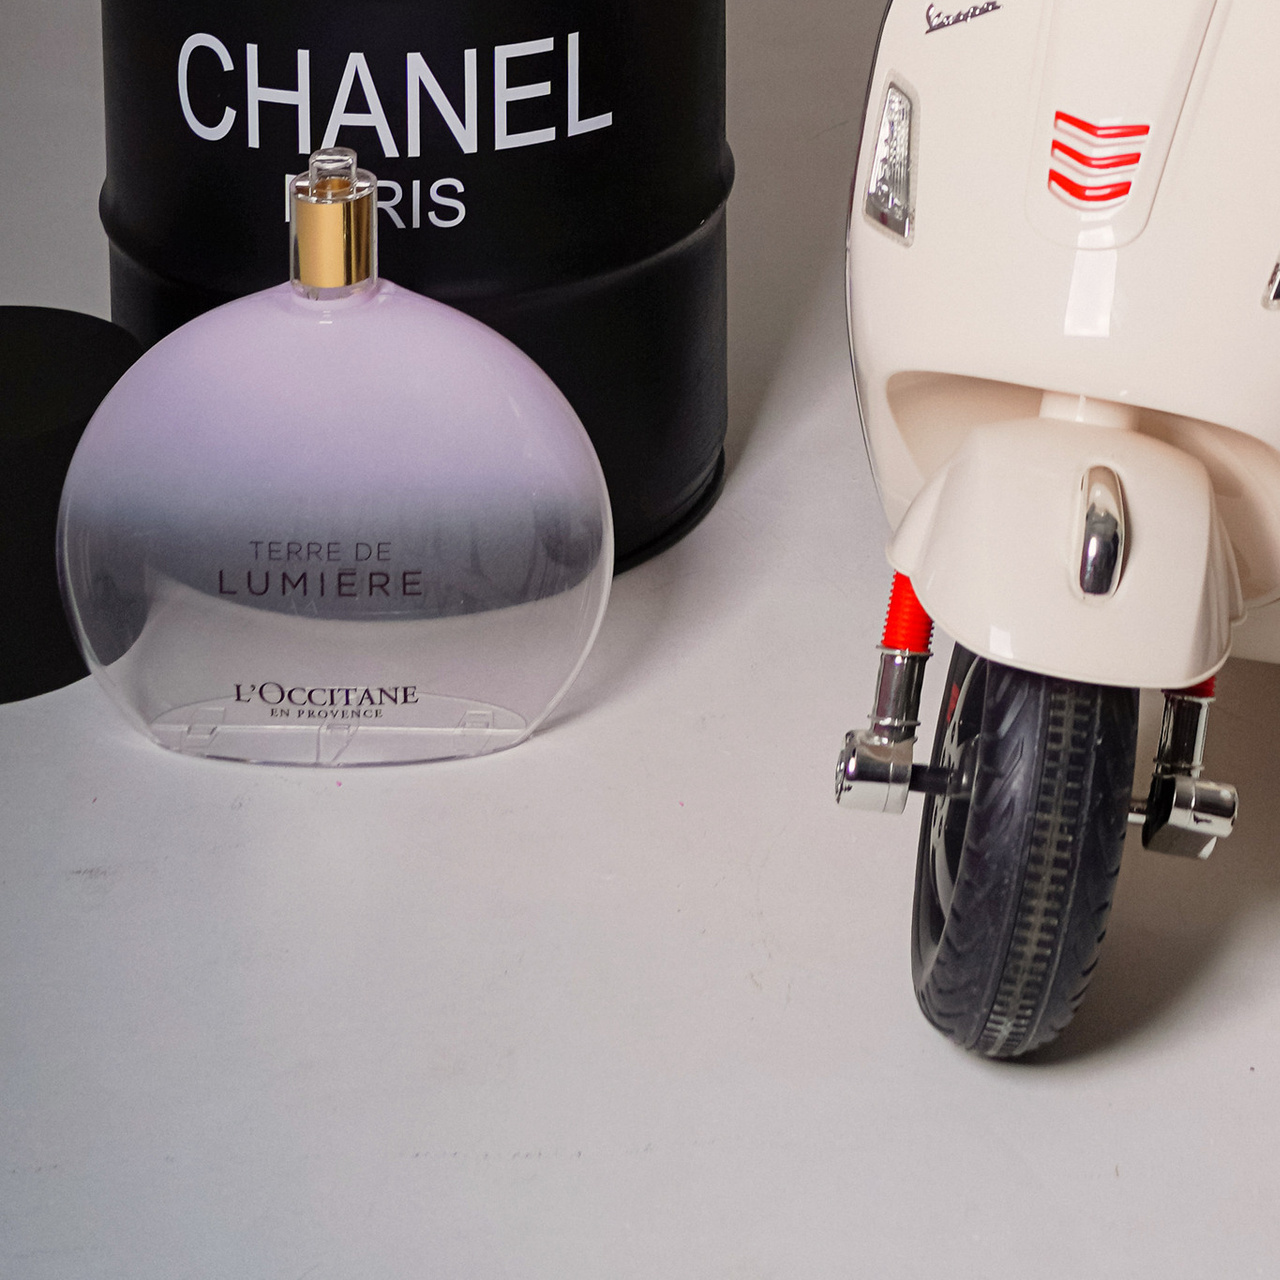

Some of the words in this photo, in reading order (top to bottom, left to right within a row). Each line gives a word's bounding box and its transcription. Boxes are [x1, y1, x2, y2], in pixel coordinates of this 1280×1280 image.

[178, 31, 613, 158] CHANEL
[285, 173, 467, 229] RIS
[250, 541, 342, 562] TERRE
[355, 541, 392, 562] DE
[270, 708, 290, 718] EN
[297, 708, 383, 719] PROVENCE
